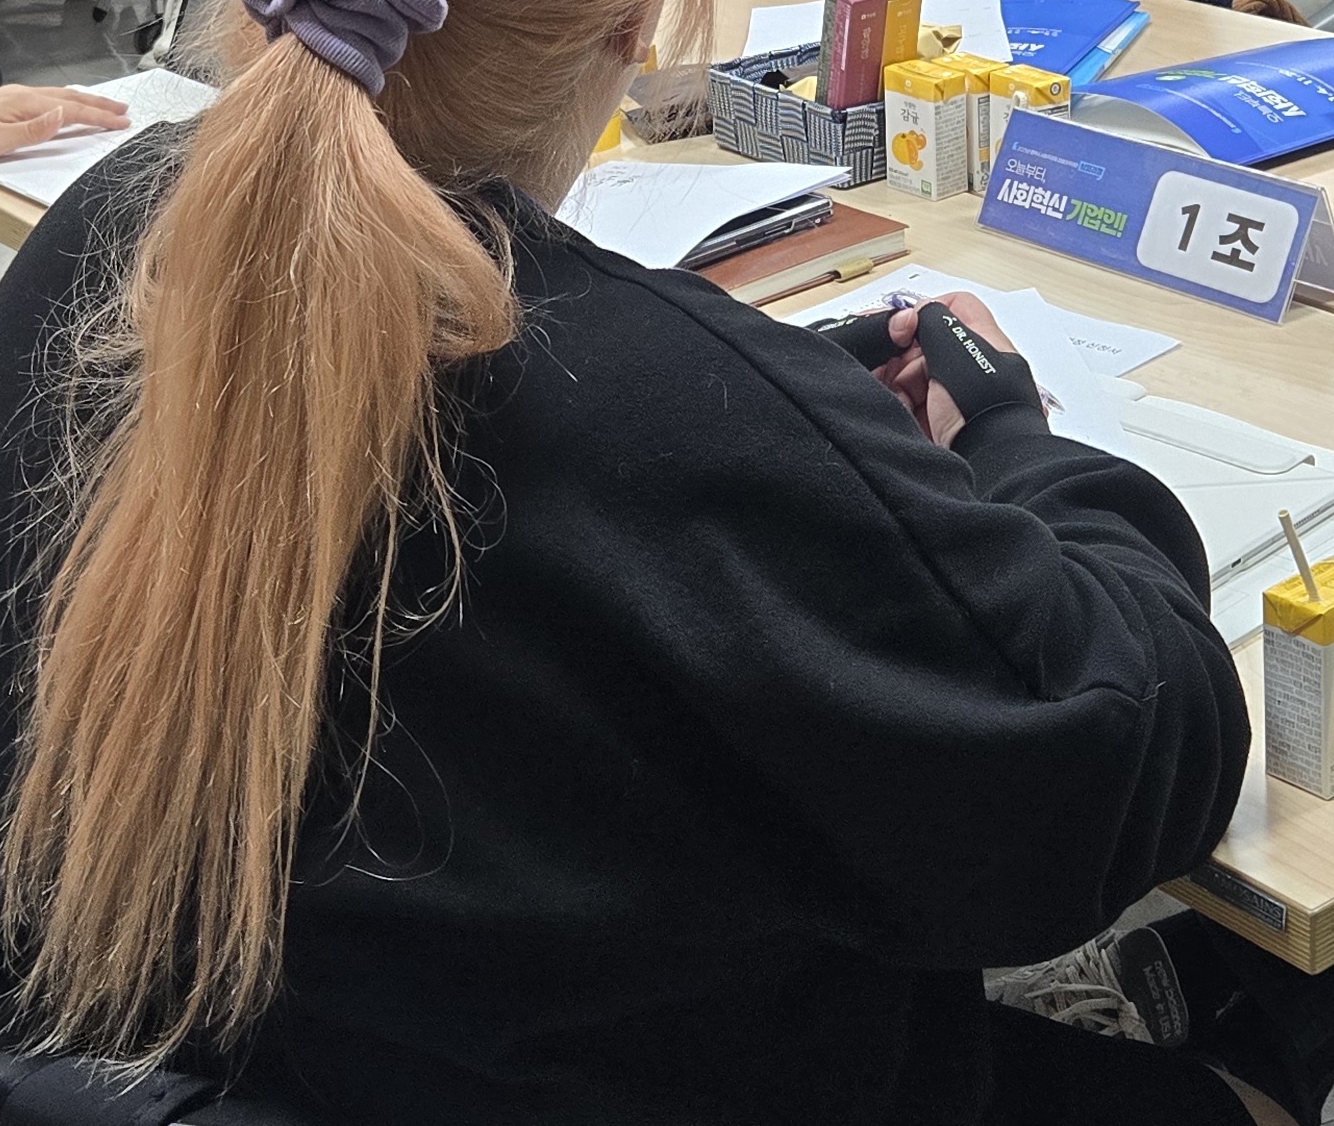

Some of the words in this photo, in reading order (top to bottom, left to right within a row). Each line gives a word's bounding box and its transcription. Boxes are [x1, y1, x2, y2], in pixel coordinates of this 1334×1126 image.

[1005, 158, 1047, 184] 오늘부터,
[996, 178, 1069, 220] 사회혁신
[1065, 198, 1129, 238] 기업인!
[1177, 203, 1201, 252] 1
[1210, 212, 1266, 273] 조
[952, 326, 967, 342] DR.
[963, 339, 997, 374] HONEST
